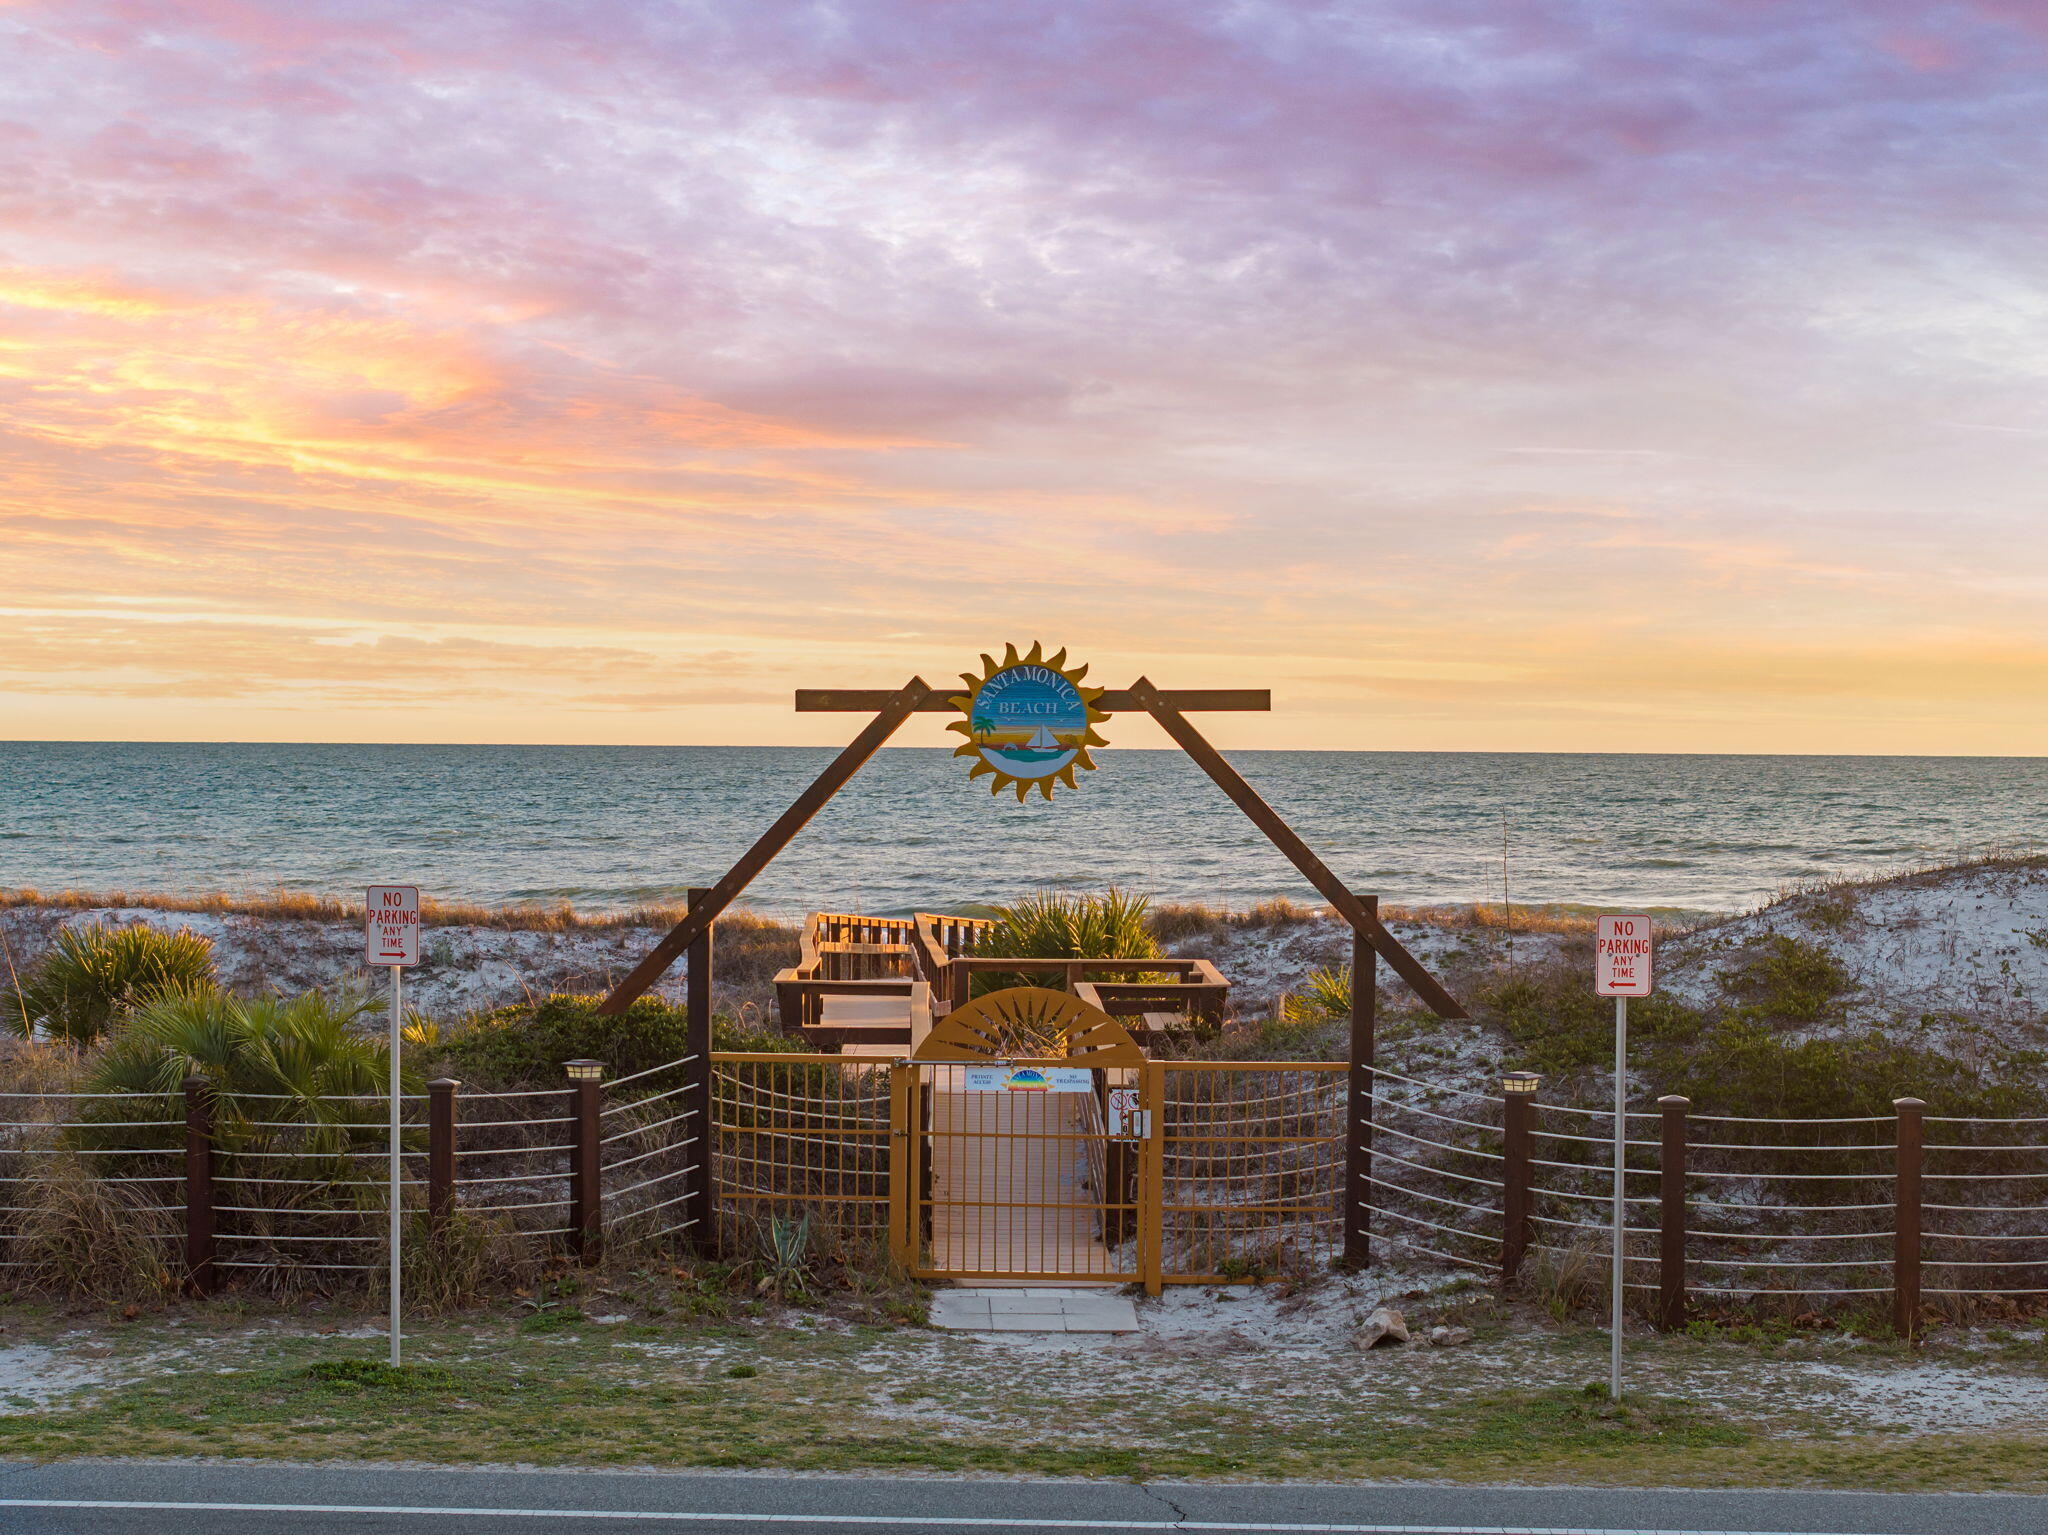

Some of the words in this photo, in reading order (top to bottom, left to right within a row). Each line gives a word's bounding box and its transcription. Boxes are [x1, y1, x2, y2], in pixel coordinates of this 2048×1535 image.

[977, 668, 1021, 709] SANTA
[1023, 666, 1081, 711] MONICA
[999, 702, 1058, 714] BEACH
[383, 892, 402, 907] NO
[369, 909, 417, 924] PARKING
[382, 926, 403, 936] ANY
[1614, 921, 1634, 936] NO
[382, 937, 404, 948] TIME
[1599, 939, 1649, 954] PARKING
[1613, 955, 1634, 966] ANY
[1612, 967, 1635, 978] TIME
